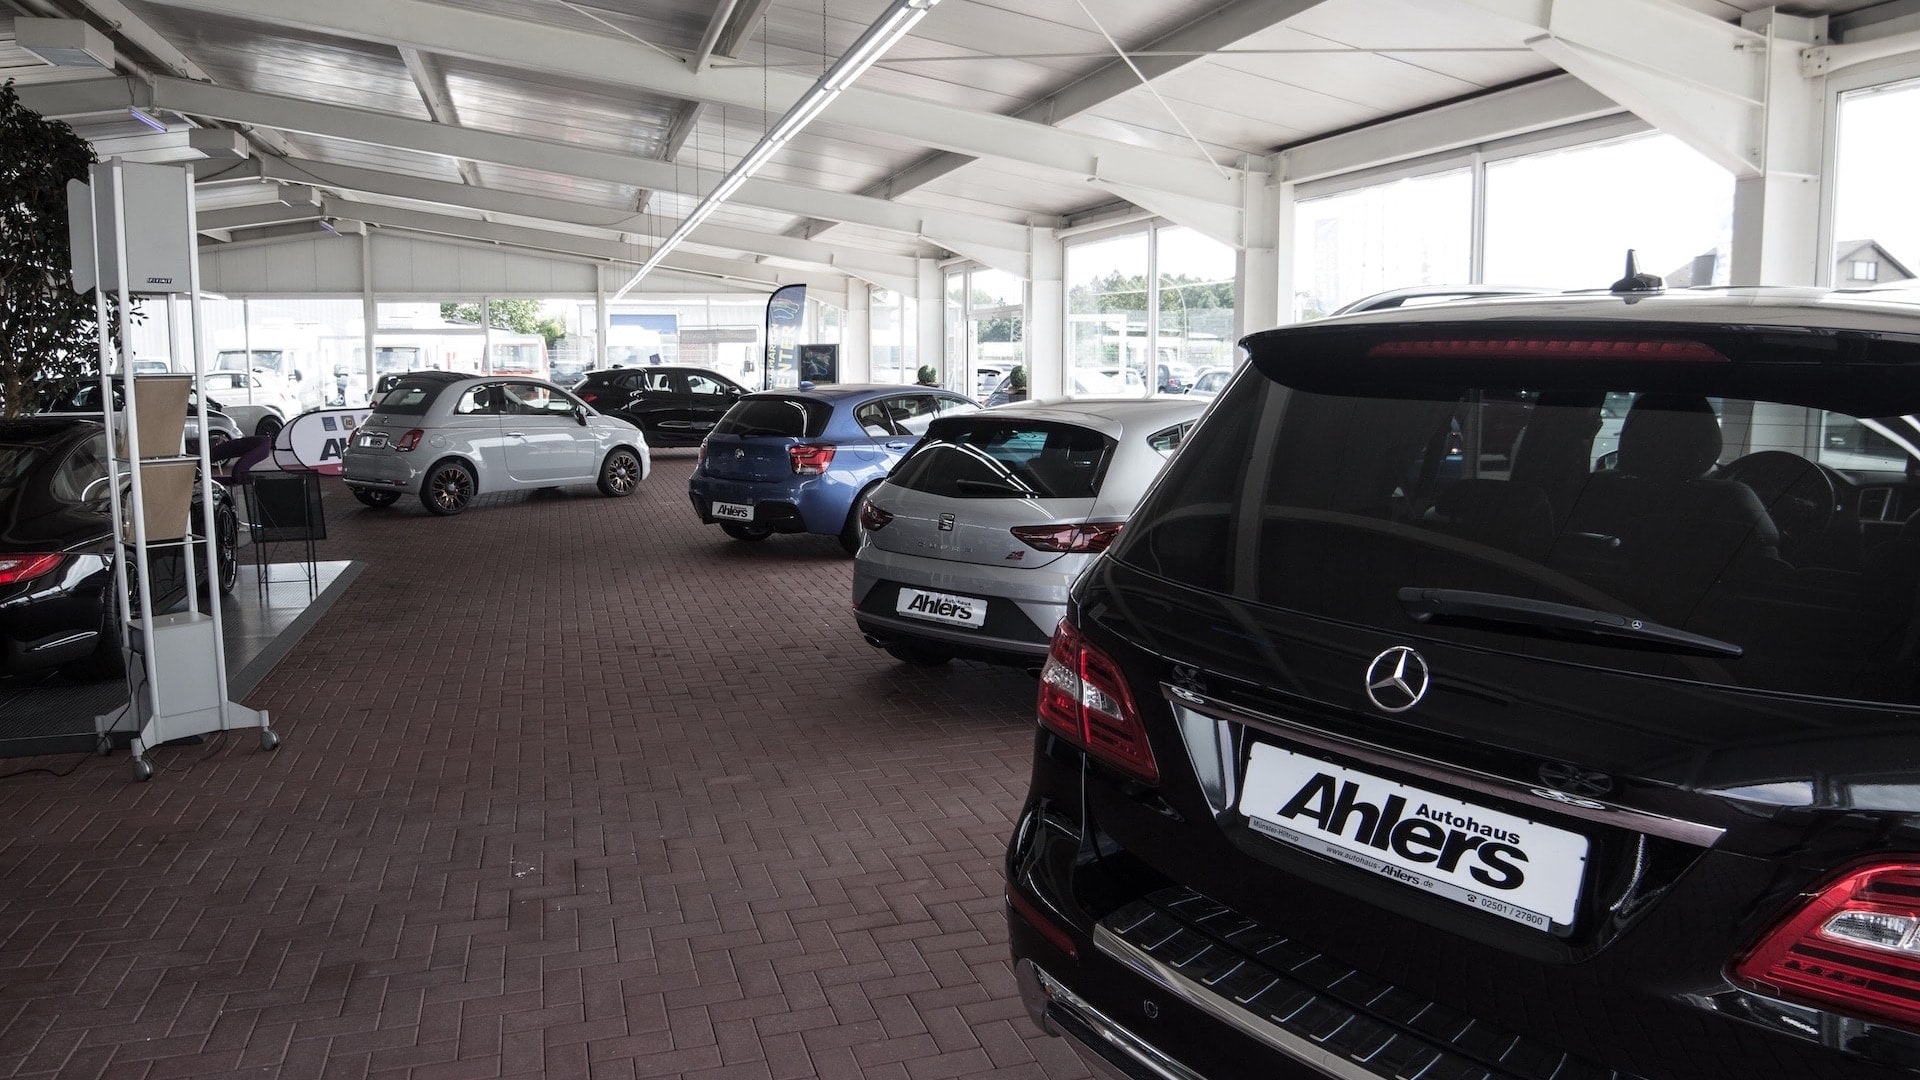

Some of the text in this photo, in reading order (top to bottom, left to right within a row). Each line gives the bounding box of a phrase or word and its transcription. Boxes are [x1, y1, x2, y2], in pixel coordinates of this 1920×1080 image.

[717, 504, 748, 518] Ahlers
[907, 593, 972, 620] Ahlers
[1276, 772, 1530, 890] Ahlers
[1415, 803, 1521, 845] Autohaus
[1481, 898, 1508, 914] 02501
[1515, 908, 1543, 926] 27800
